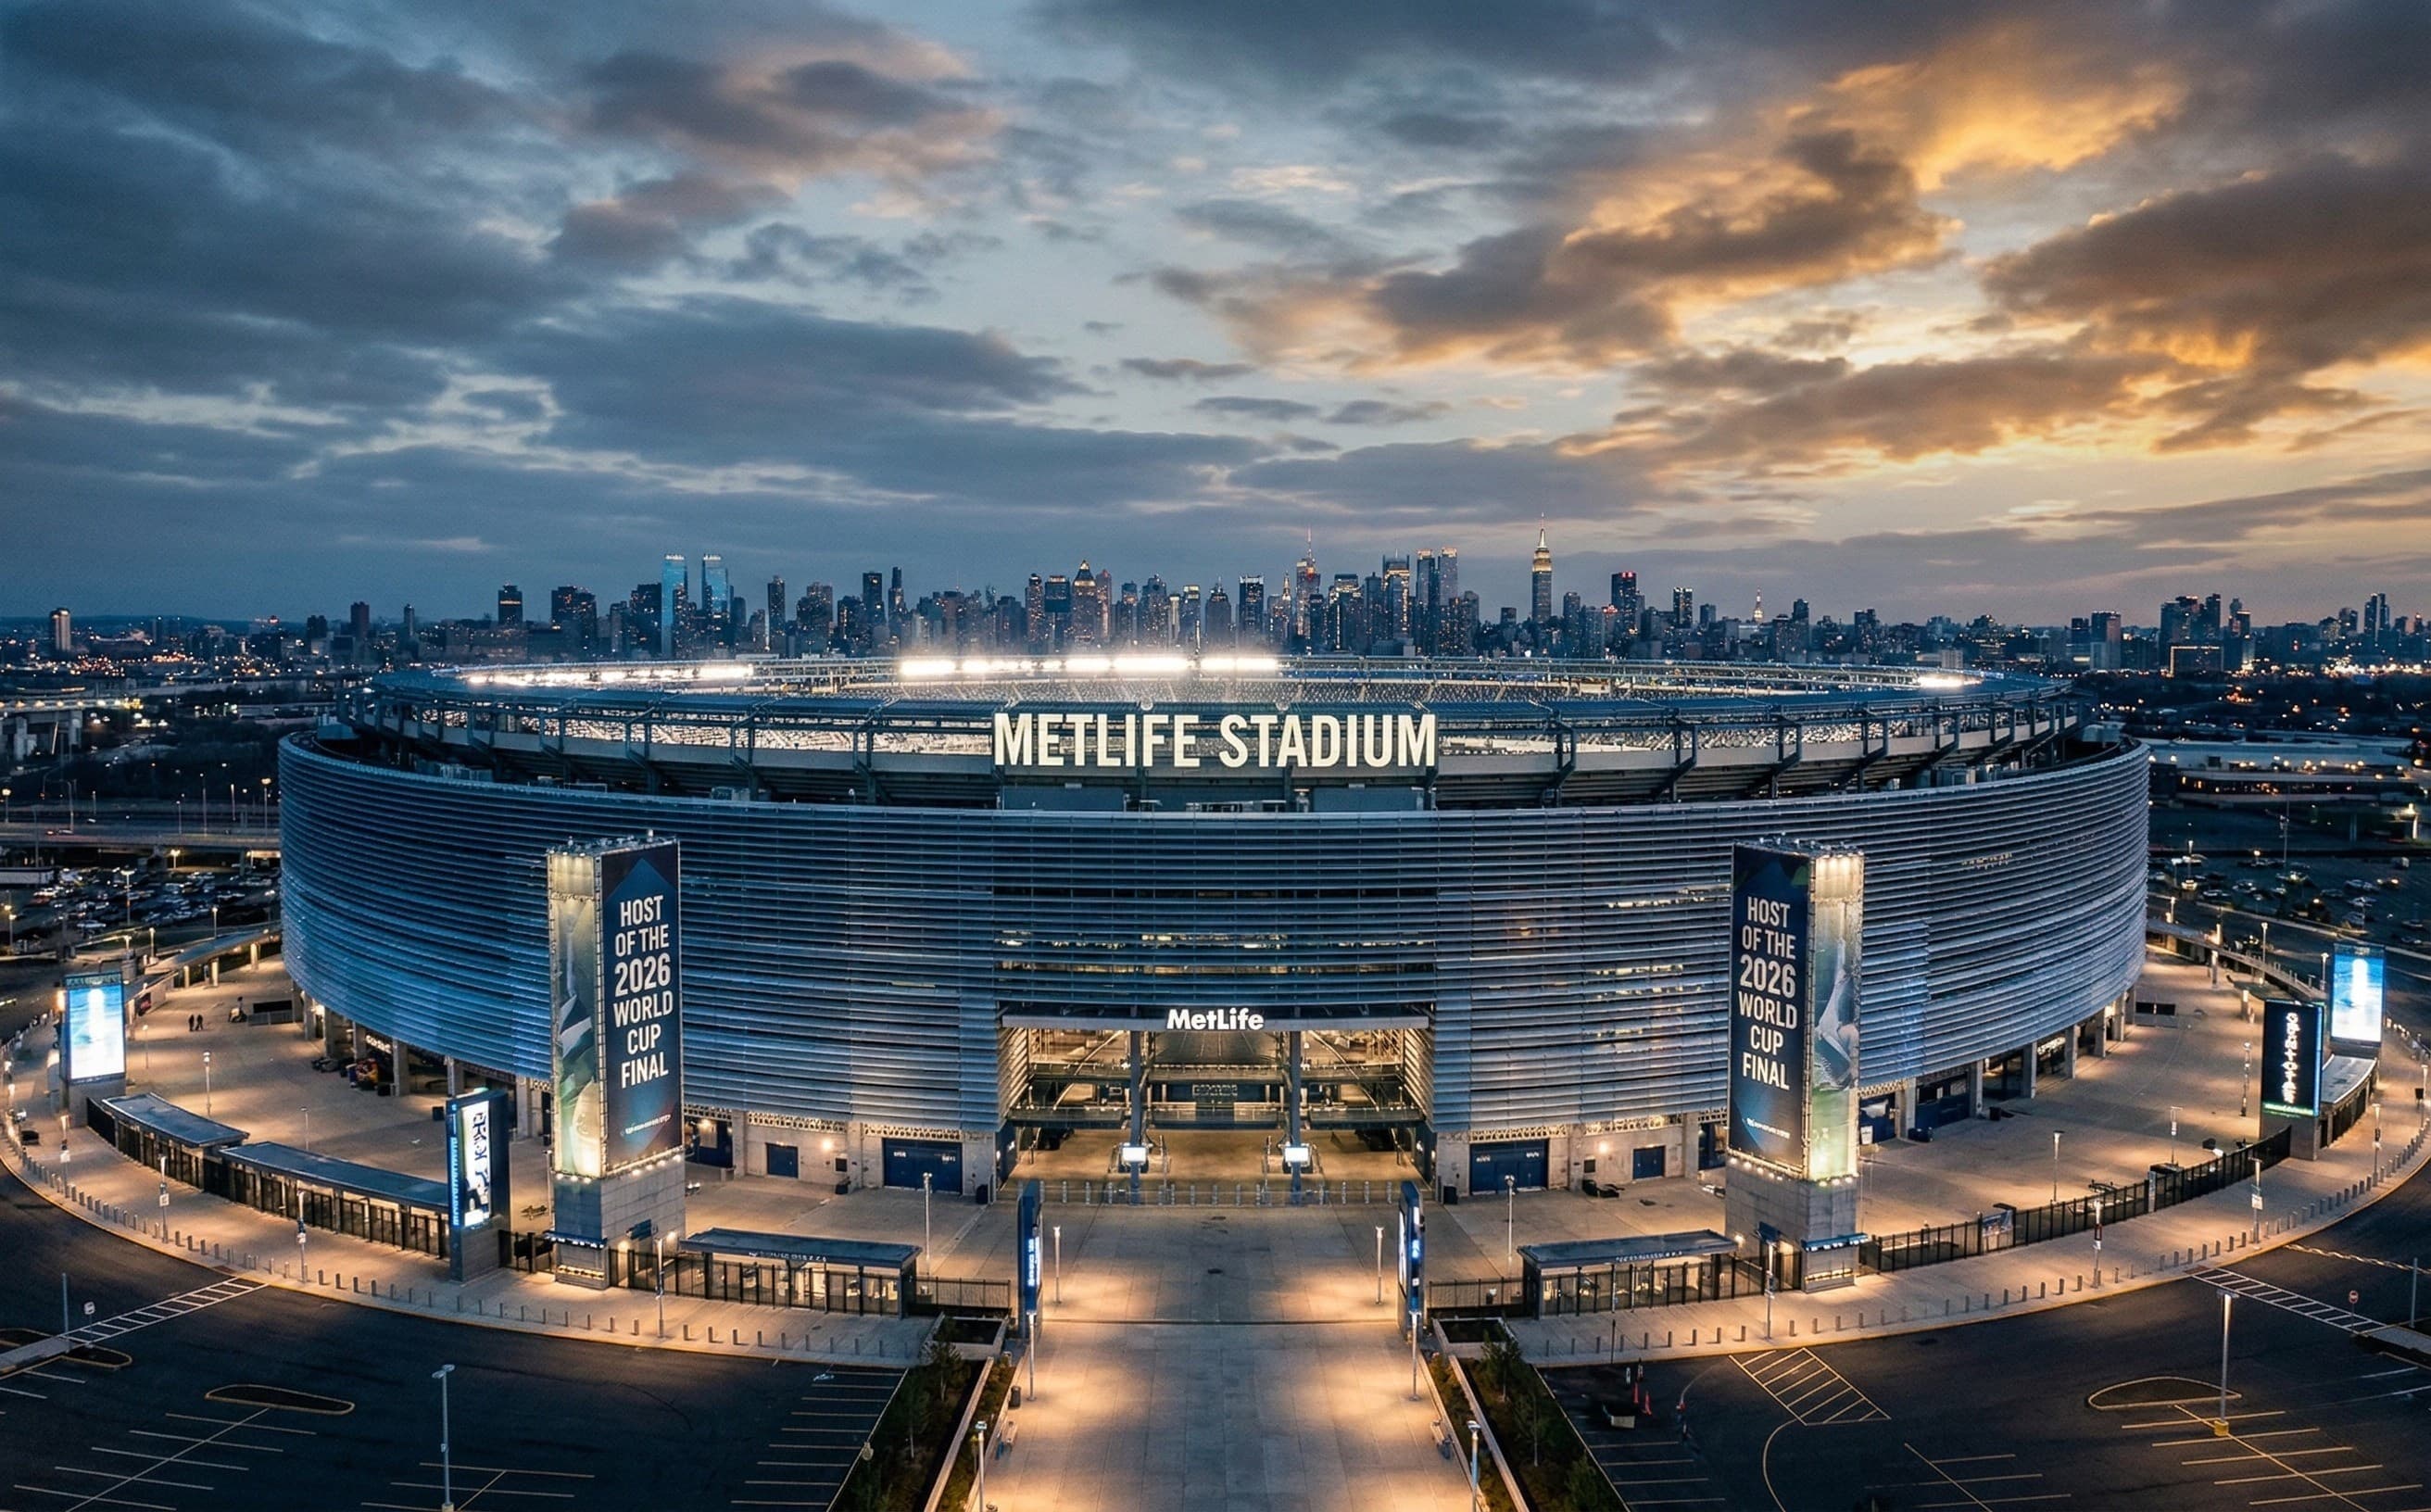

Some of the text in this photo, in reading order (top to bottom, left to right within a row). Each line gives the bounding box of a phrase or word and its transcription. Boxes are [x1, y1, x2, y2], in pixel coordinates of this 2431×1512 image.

[994, 712, 1435, 768] METLIFE STADIUM
[621, 895, 663, 926] HOST
[1747, 896, 1790, 927] HOST
[615, 924, 669, 957] OF THE
[1742, 925, 1795, 960] OF THE
[615, 952, 671, 997] 2026
[1740, 955, 1796, 999] 2026
[613, 990, 673, 1027] WORLD
[1166, 1007, 1265, 1030] MetLife
[1738, 991, 1797, 1029] WORLD
[627, 1024, 661, 1055] CUP
[1750, 1025, 1784, 1056] CUP
[621, 1052, 669, 1089] FINAL
[1743, 1052, 1790, 1090] FINAL
